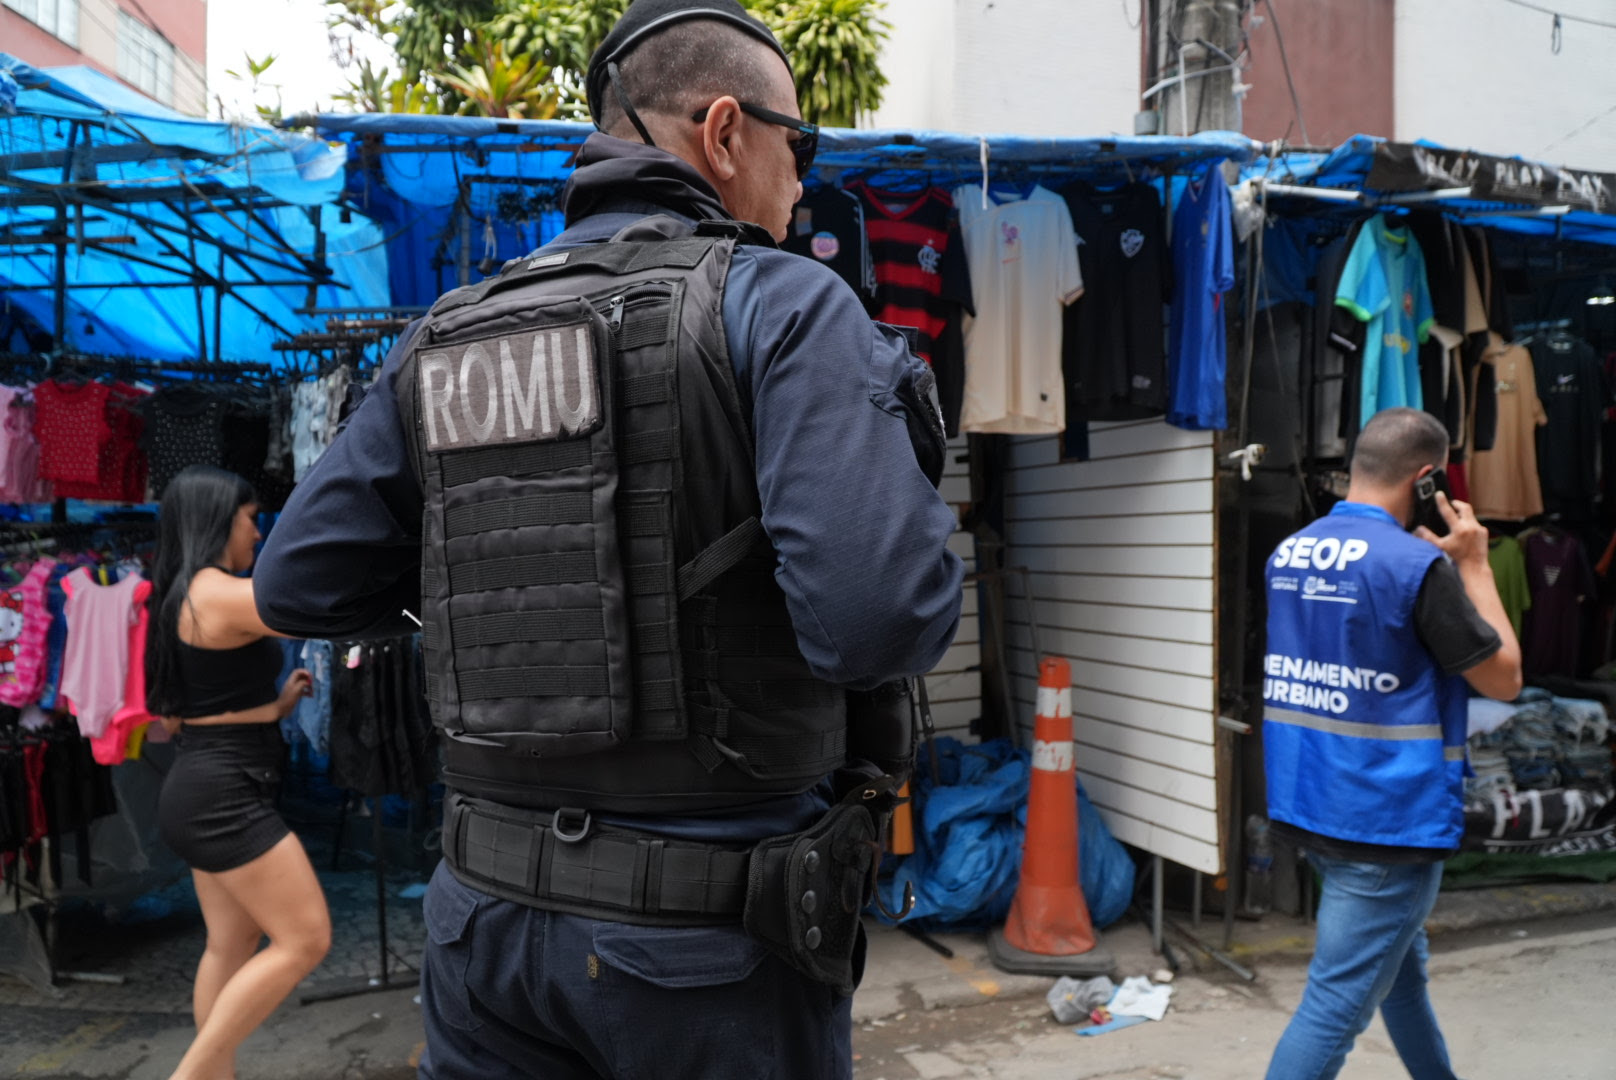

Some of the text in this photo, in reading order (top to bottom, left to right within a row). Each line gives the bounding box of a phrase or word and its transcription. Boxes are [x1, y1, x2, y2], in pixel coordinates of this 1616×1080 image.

[420, 328, 592, 445] ROMU
[1273, 537, 1369, 571] SEOP
[1263, 654, 1400, 693] ENAMENTO
